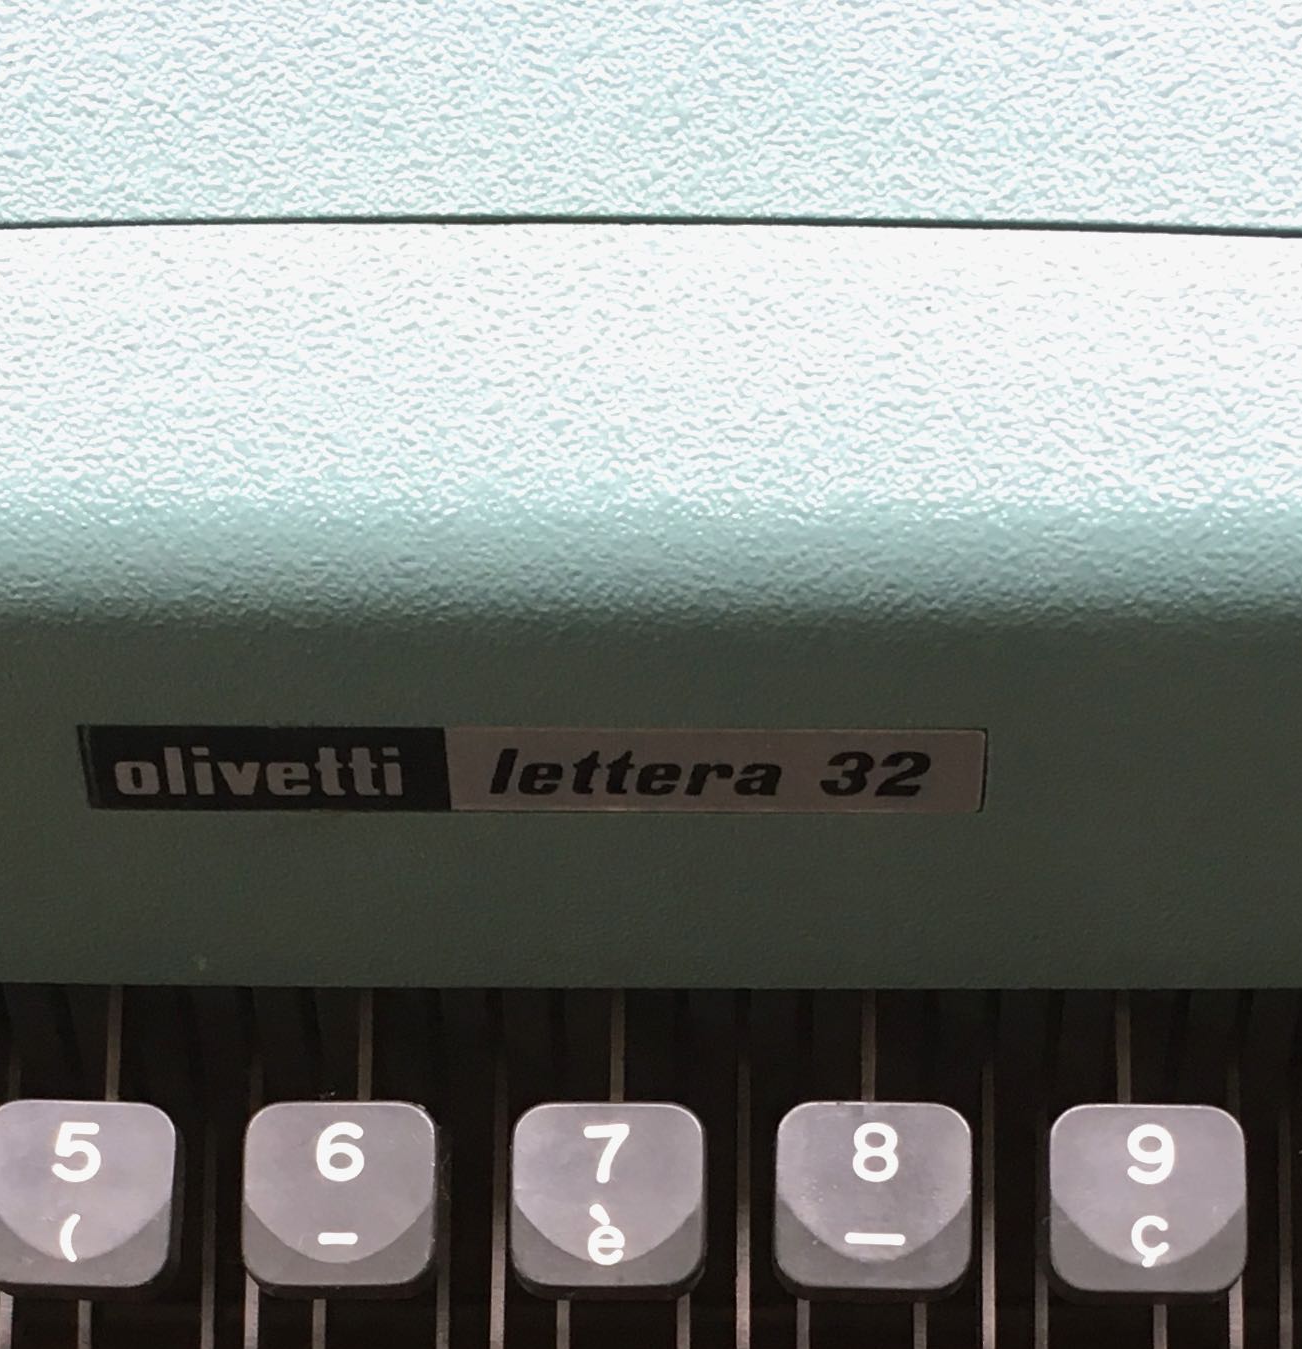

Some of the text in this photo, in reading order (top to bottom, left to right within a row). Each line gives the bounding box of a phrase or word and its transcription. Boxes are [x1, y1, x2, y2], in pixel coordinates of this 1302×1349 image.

[113, 747, 933, 798] olivetti lettera 32
[51, 1121, 102, 1183] 5
[316, 1121, 365, 1182] 6
[583, 1123, 630, 1184] 7
[852, 1122, 899, 1183] 8
[1127, 1123, 1175, 1185] 9
[59, 1213, 81, 1263] (
[587, 1203, 626, 1266] è
[1131, 1215, 1170, 1268] ç
